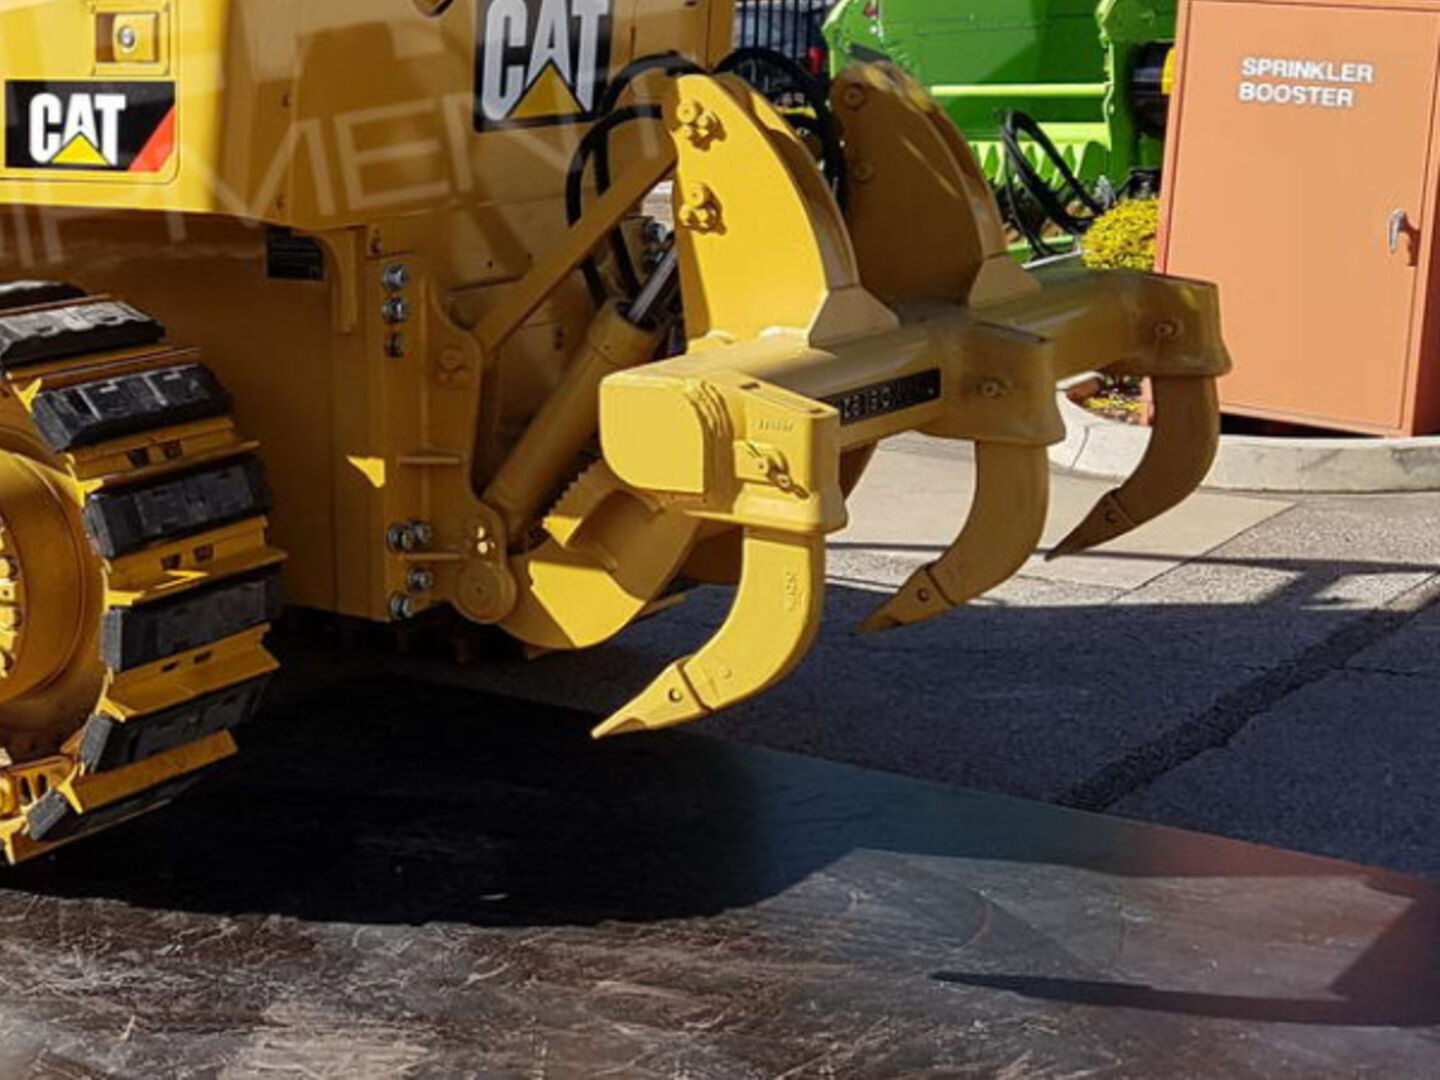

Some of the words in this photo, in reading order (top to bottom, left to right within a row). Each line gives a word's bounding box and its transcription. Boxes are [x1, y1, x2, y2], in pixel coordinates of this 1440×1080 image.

[1241, 57, 1373, 83] SPRINKLER
[1238, 81, 1354, 107] BOOSTER
[28, 93, 126, 166] CAT
